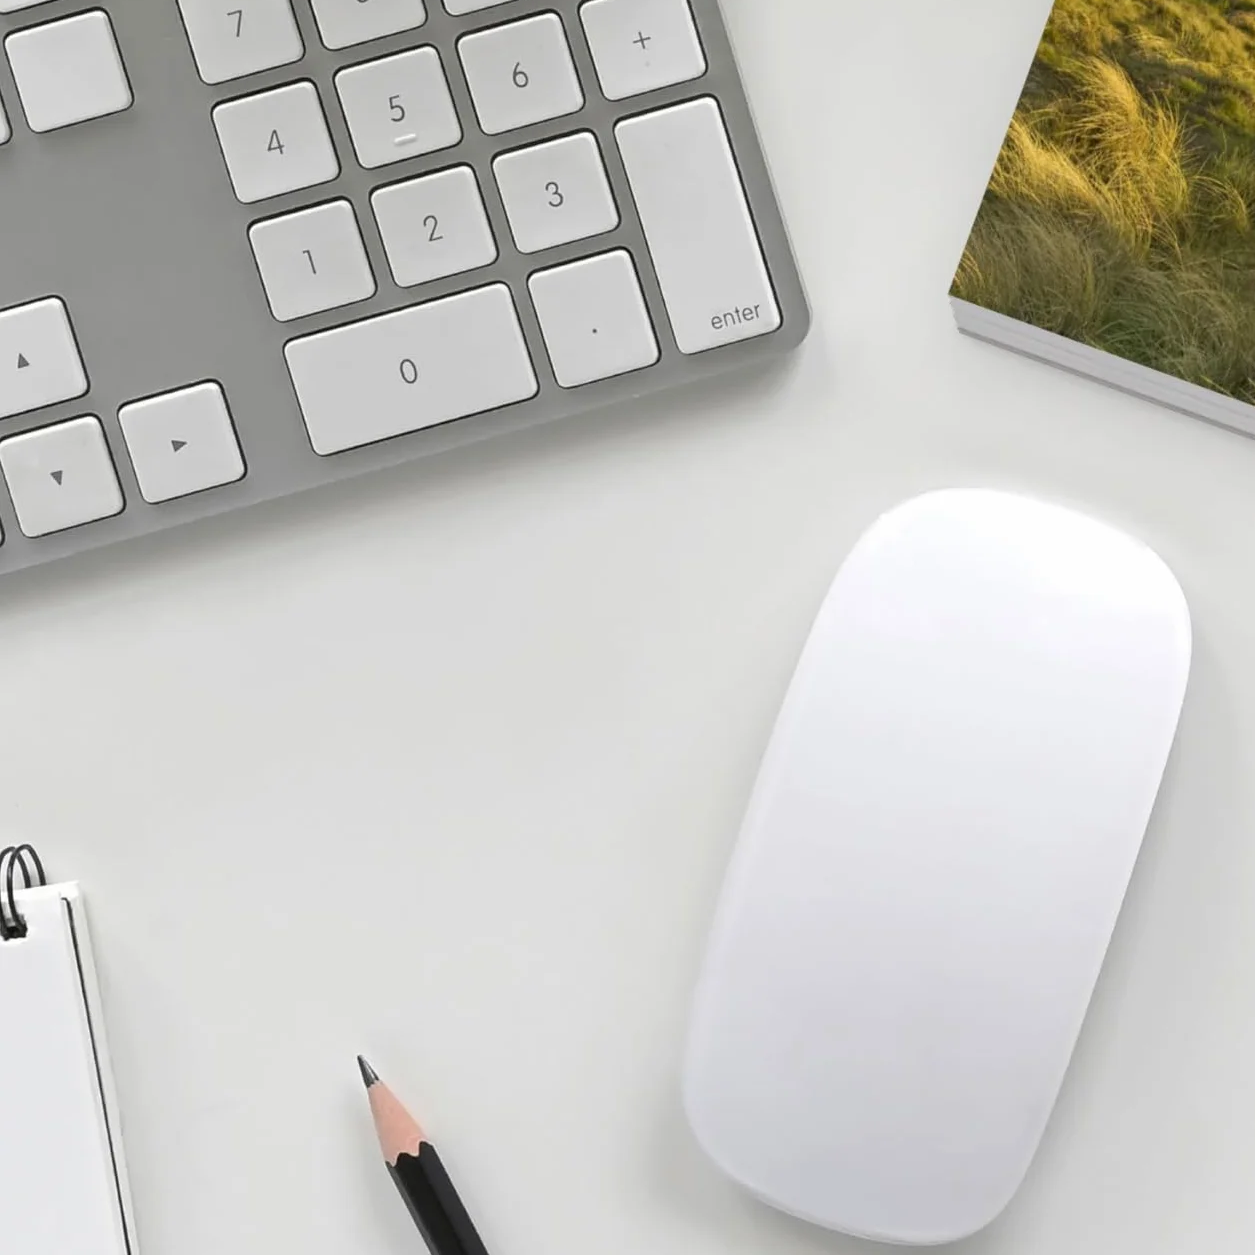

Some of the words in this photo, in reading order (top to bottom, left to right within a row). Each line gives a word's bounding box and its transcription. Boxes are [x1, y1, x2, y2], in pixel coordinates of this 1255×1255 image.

[226, 9, 245, 39] 7
[512, 61, 530, 89] 6
[388, 94, 406, 123] 5
[265, 128, 285, 156] 4
[544, 181, 565, 209] 3
[422, 214, 444, 242] 2
[302, 248, 318, 276] 1
[709, 301, 762, 331] enter
